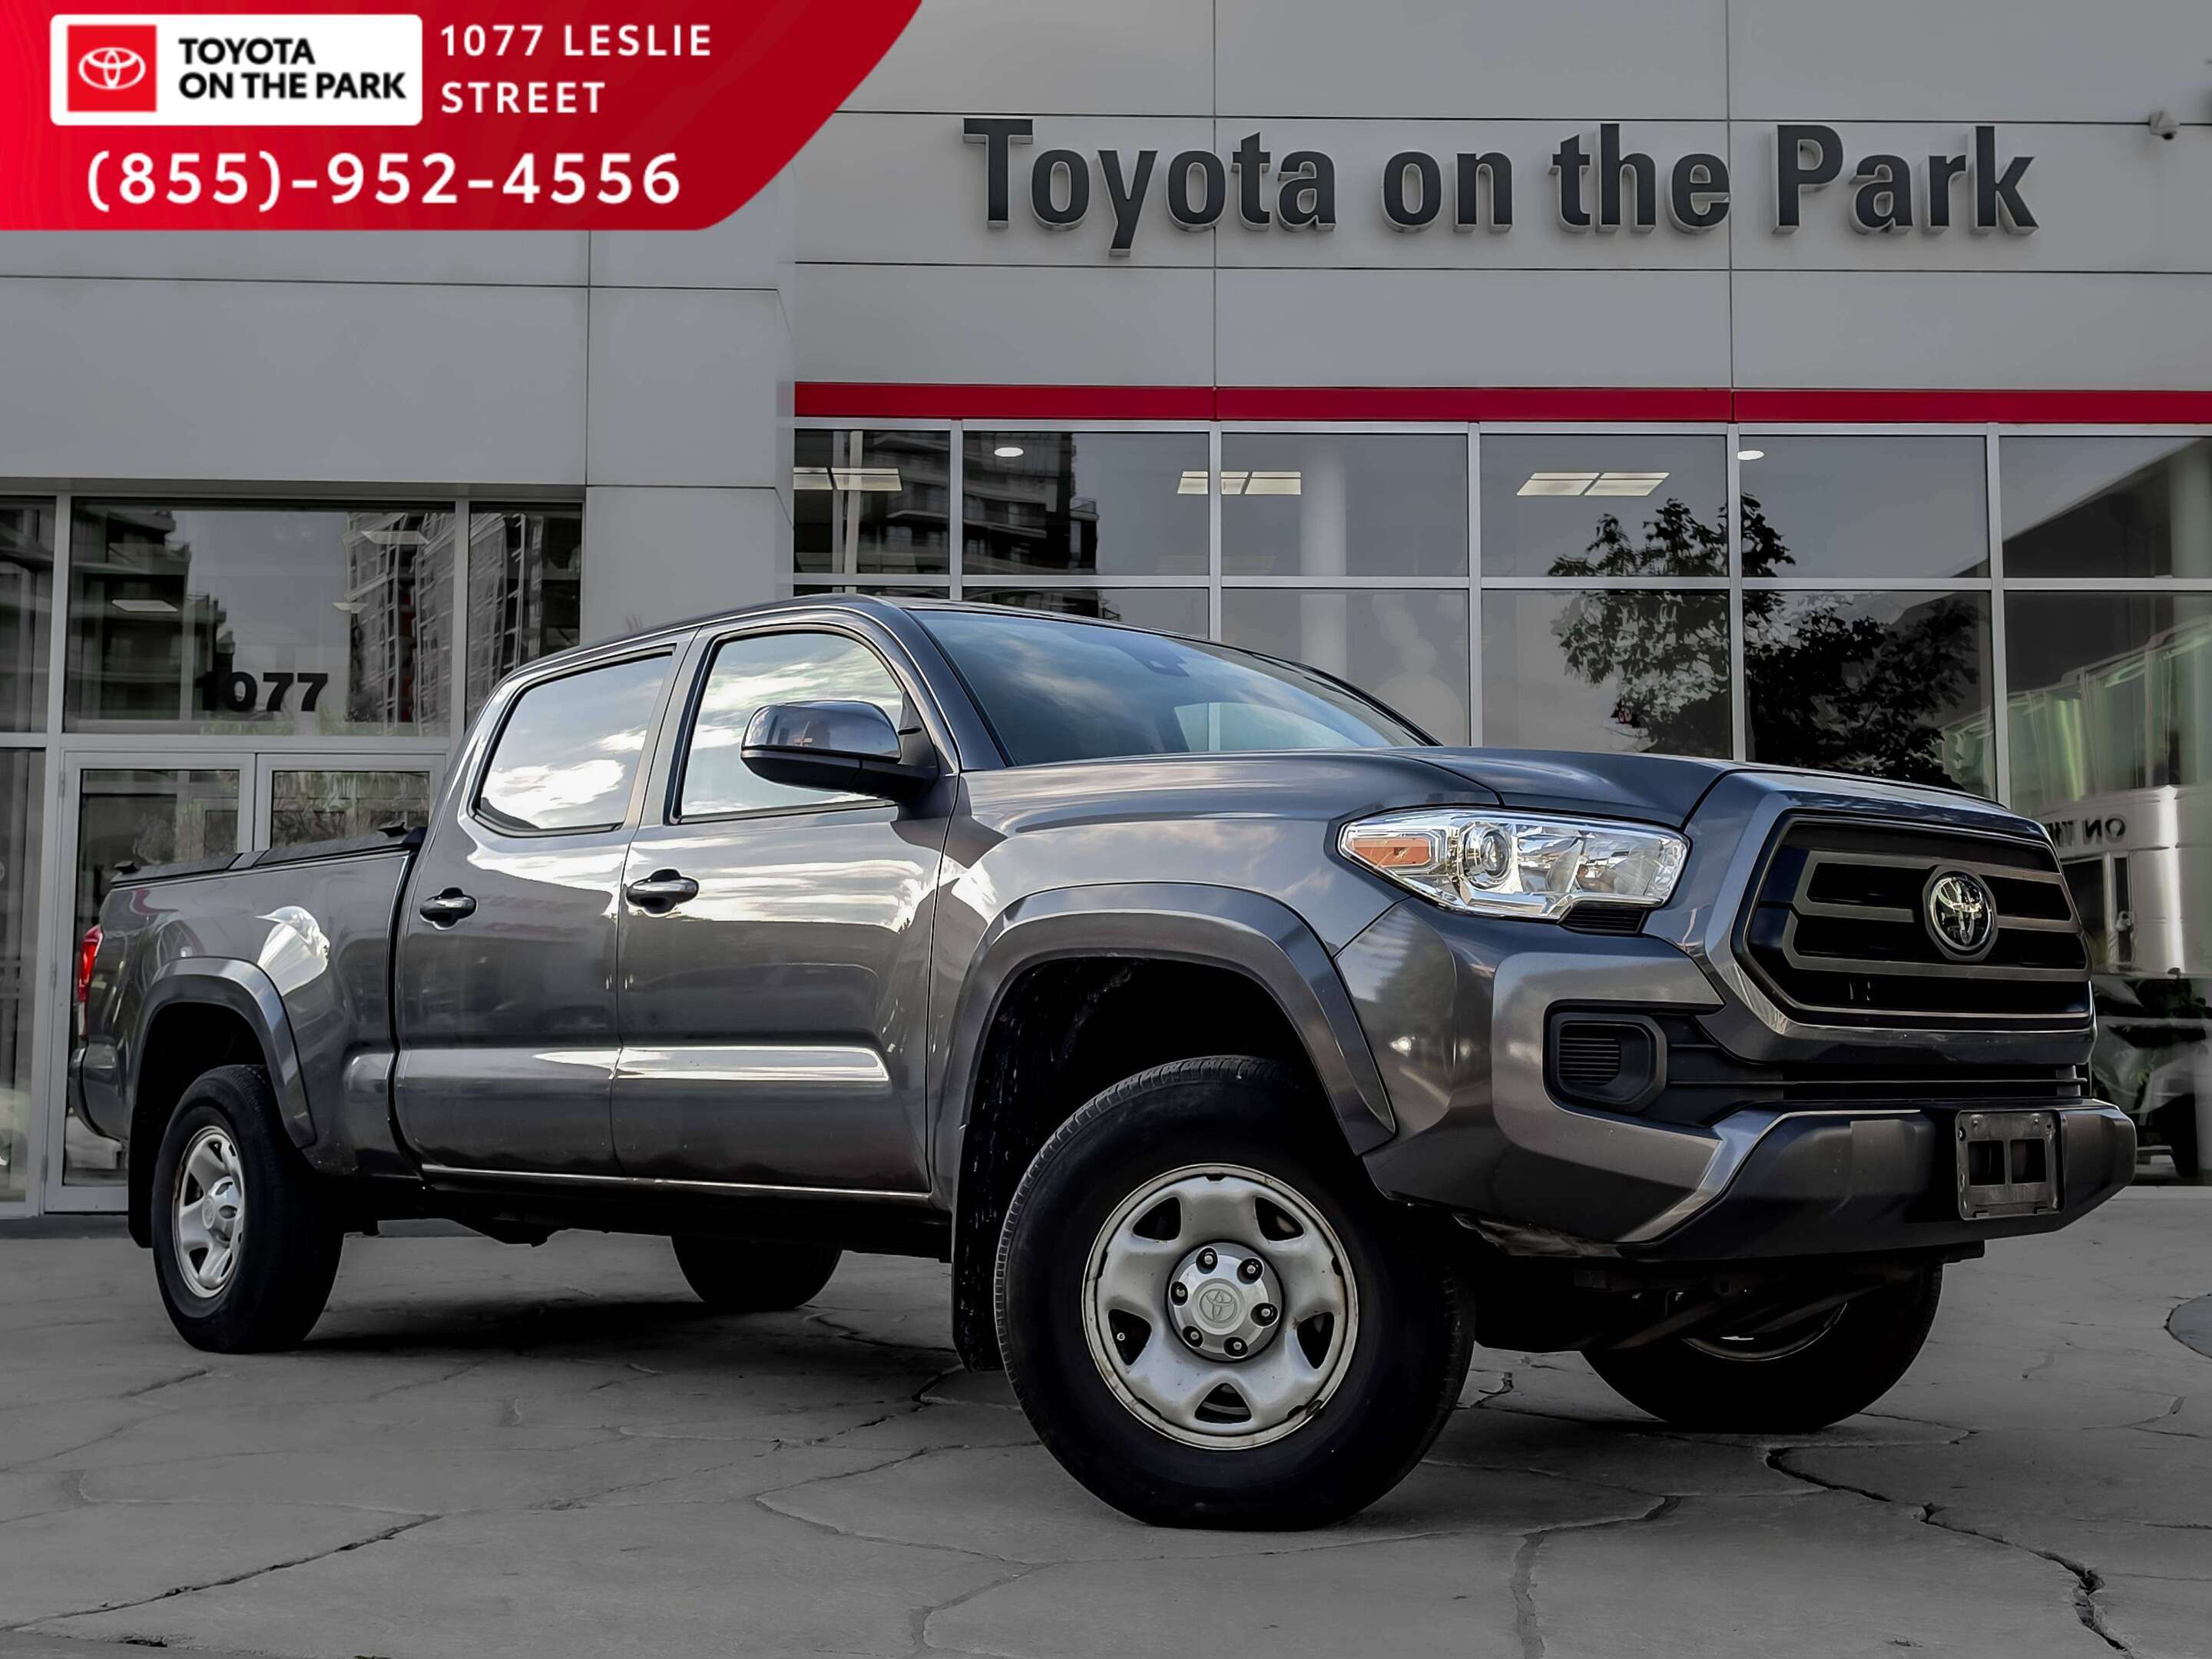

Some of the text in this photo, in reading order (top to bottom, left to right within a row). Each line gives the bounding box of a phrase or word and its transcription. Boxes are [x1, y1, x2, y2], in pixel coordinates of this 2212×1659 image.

[963, 118, 2040, 255] Toyota on the Park
[196, 671, 329, 712] 1077
